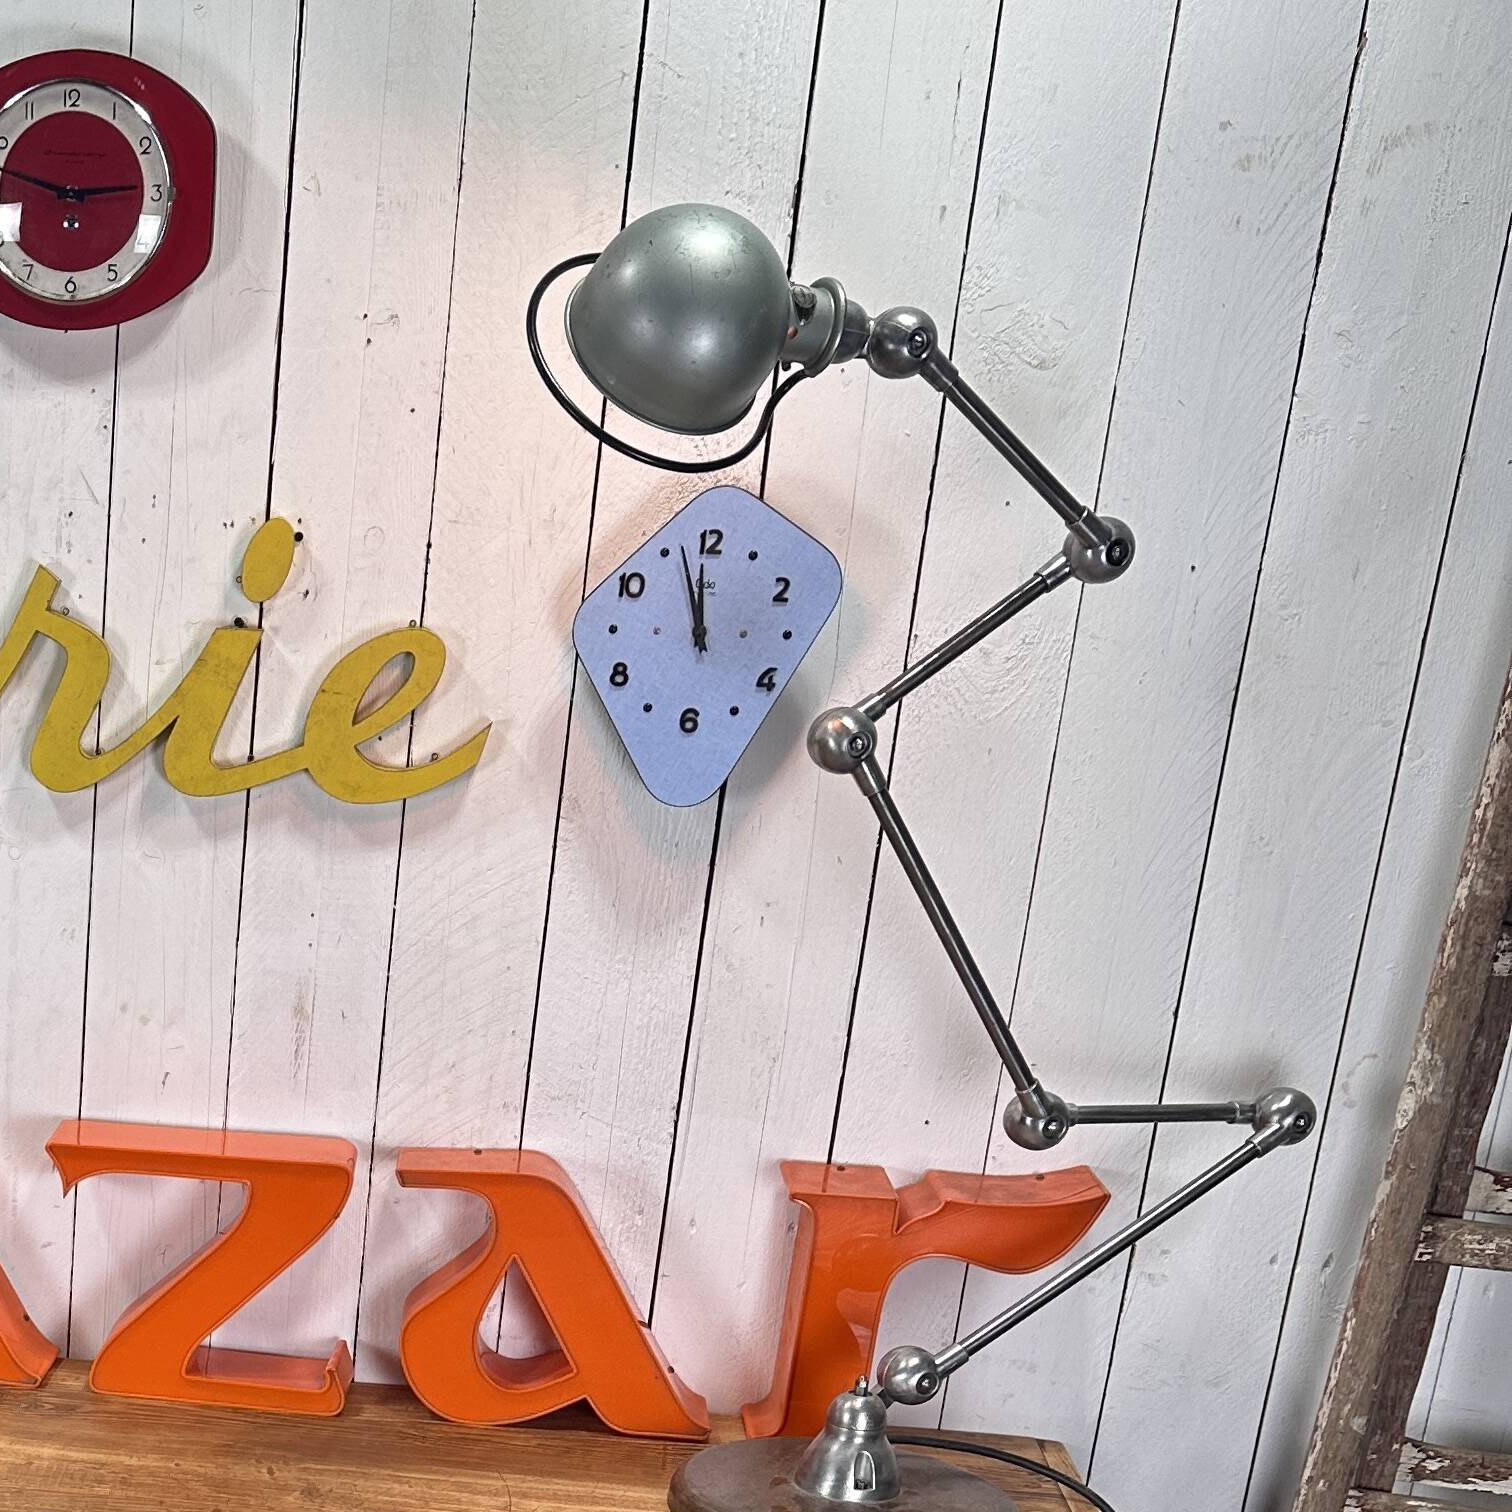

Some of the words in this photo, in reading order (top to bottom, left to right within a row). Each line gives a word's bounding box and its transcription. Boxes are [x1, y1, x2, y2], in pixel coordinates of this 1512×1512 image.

[64, 88, 81, 108] 12
[25, 102, 34, 120] 11
[139, 136, 152, 155] 2
[150, 184, 162, 201] 3
[22, 264, 34, 281] 7
[107, 264, 118, 282] 5
[64, 276, 77, 294] 6
[699, 529, 724, 556] 12
[618, 572, 645, 599] 10
[772, 577, 790, 603] 2
[609, 661, 629, 687] 8
[756, 667, 777, 691] 4
[679, 707, 699, 733] 6
